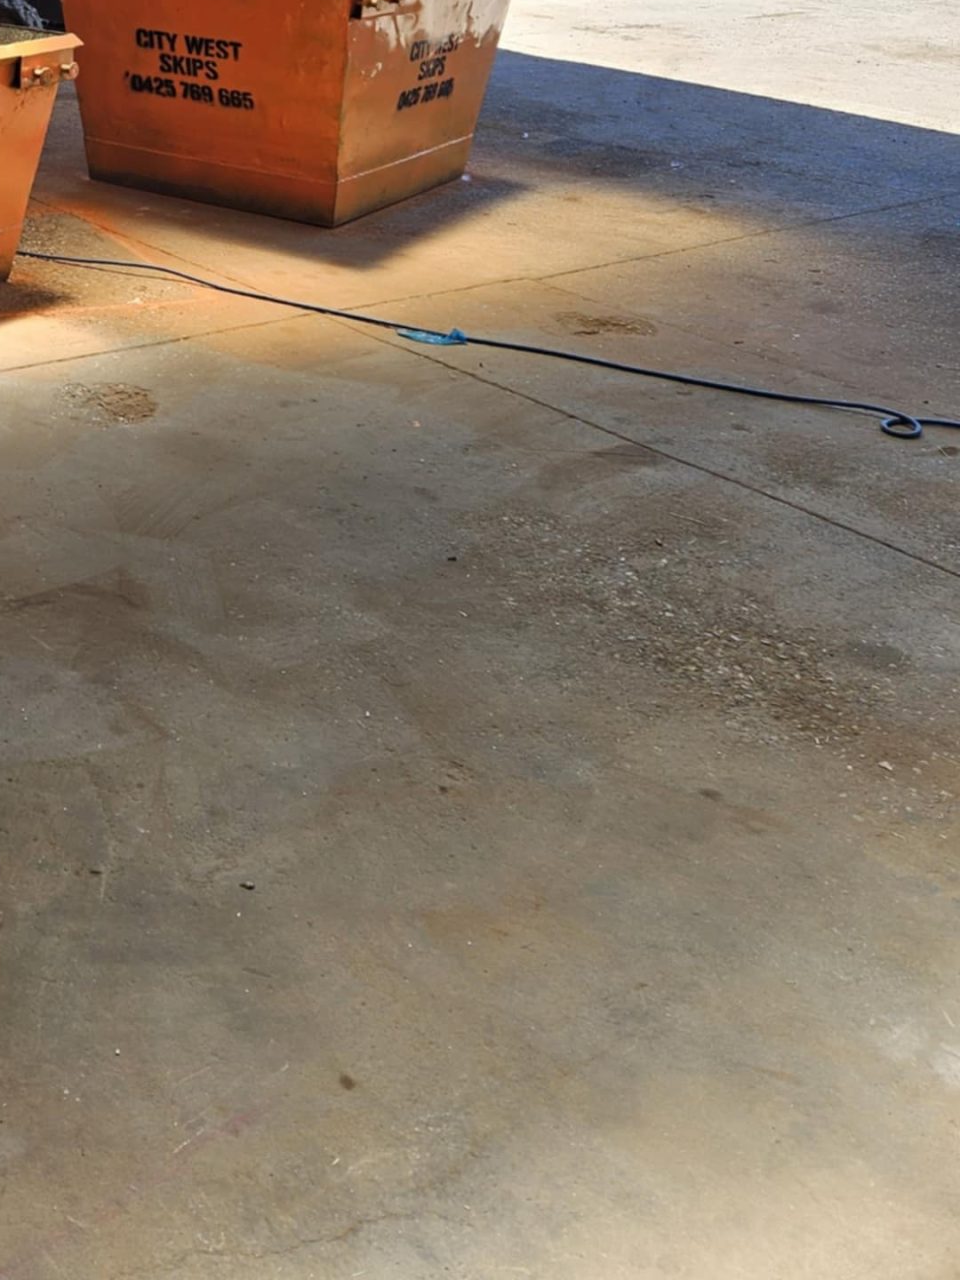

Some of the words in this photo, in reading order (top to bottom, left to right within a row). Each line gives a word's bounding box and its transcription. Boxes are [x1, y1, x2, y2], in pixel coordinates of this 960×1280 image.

[135, 28, 178, 52] CITY
[184, 35, 243, 61] WEST
[159, 53, 219, 80] SKIPS
[130, 73, 177, 98] 0425
[180, 81, 214, 104] 769
[218, 88, 255, 110] 665
